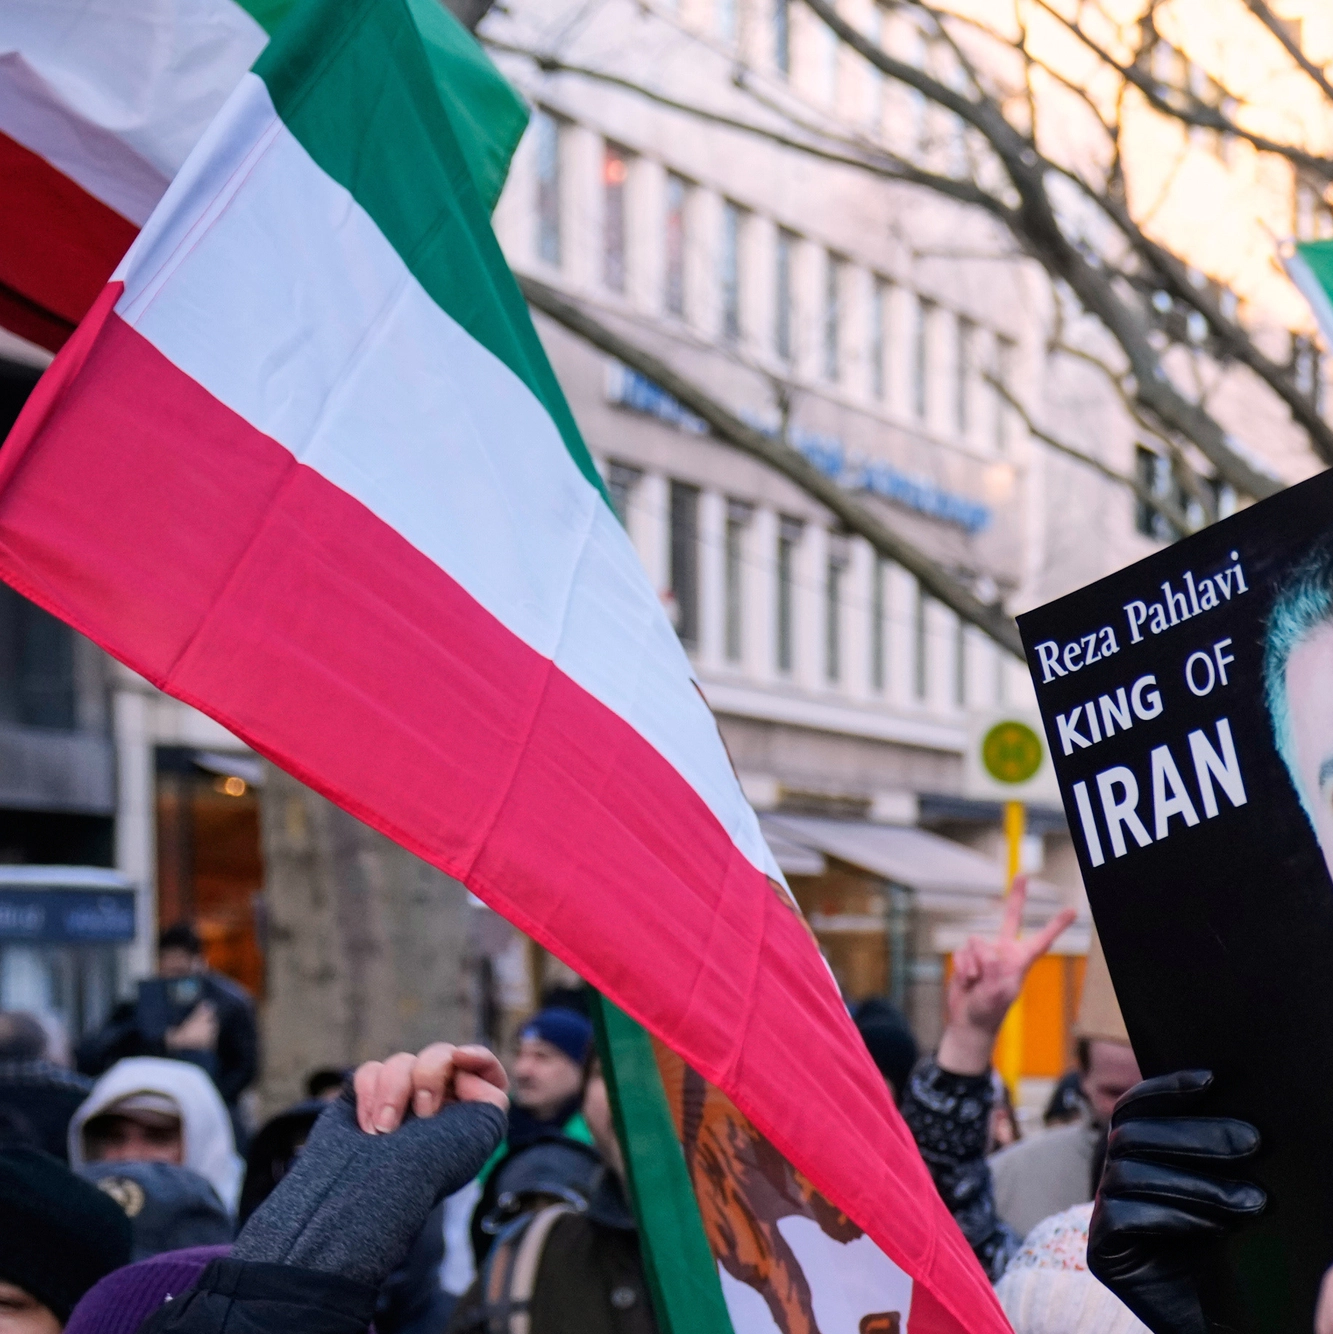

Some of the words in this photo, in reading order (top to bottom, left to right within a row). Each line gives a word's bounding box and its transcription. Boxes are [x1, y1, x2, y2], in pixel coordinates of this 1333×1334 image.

[1034, 626, 1121, 685] Reza
[1122, 549, 1249, 645] Pahlavi
[1055, 674, 1164, 757] KING
[1185, 637, 1235, 697] OF
[1072, 717, 1248, 868] IRAN
